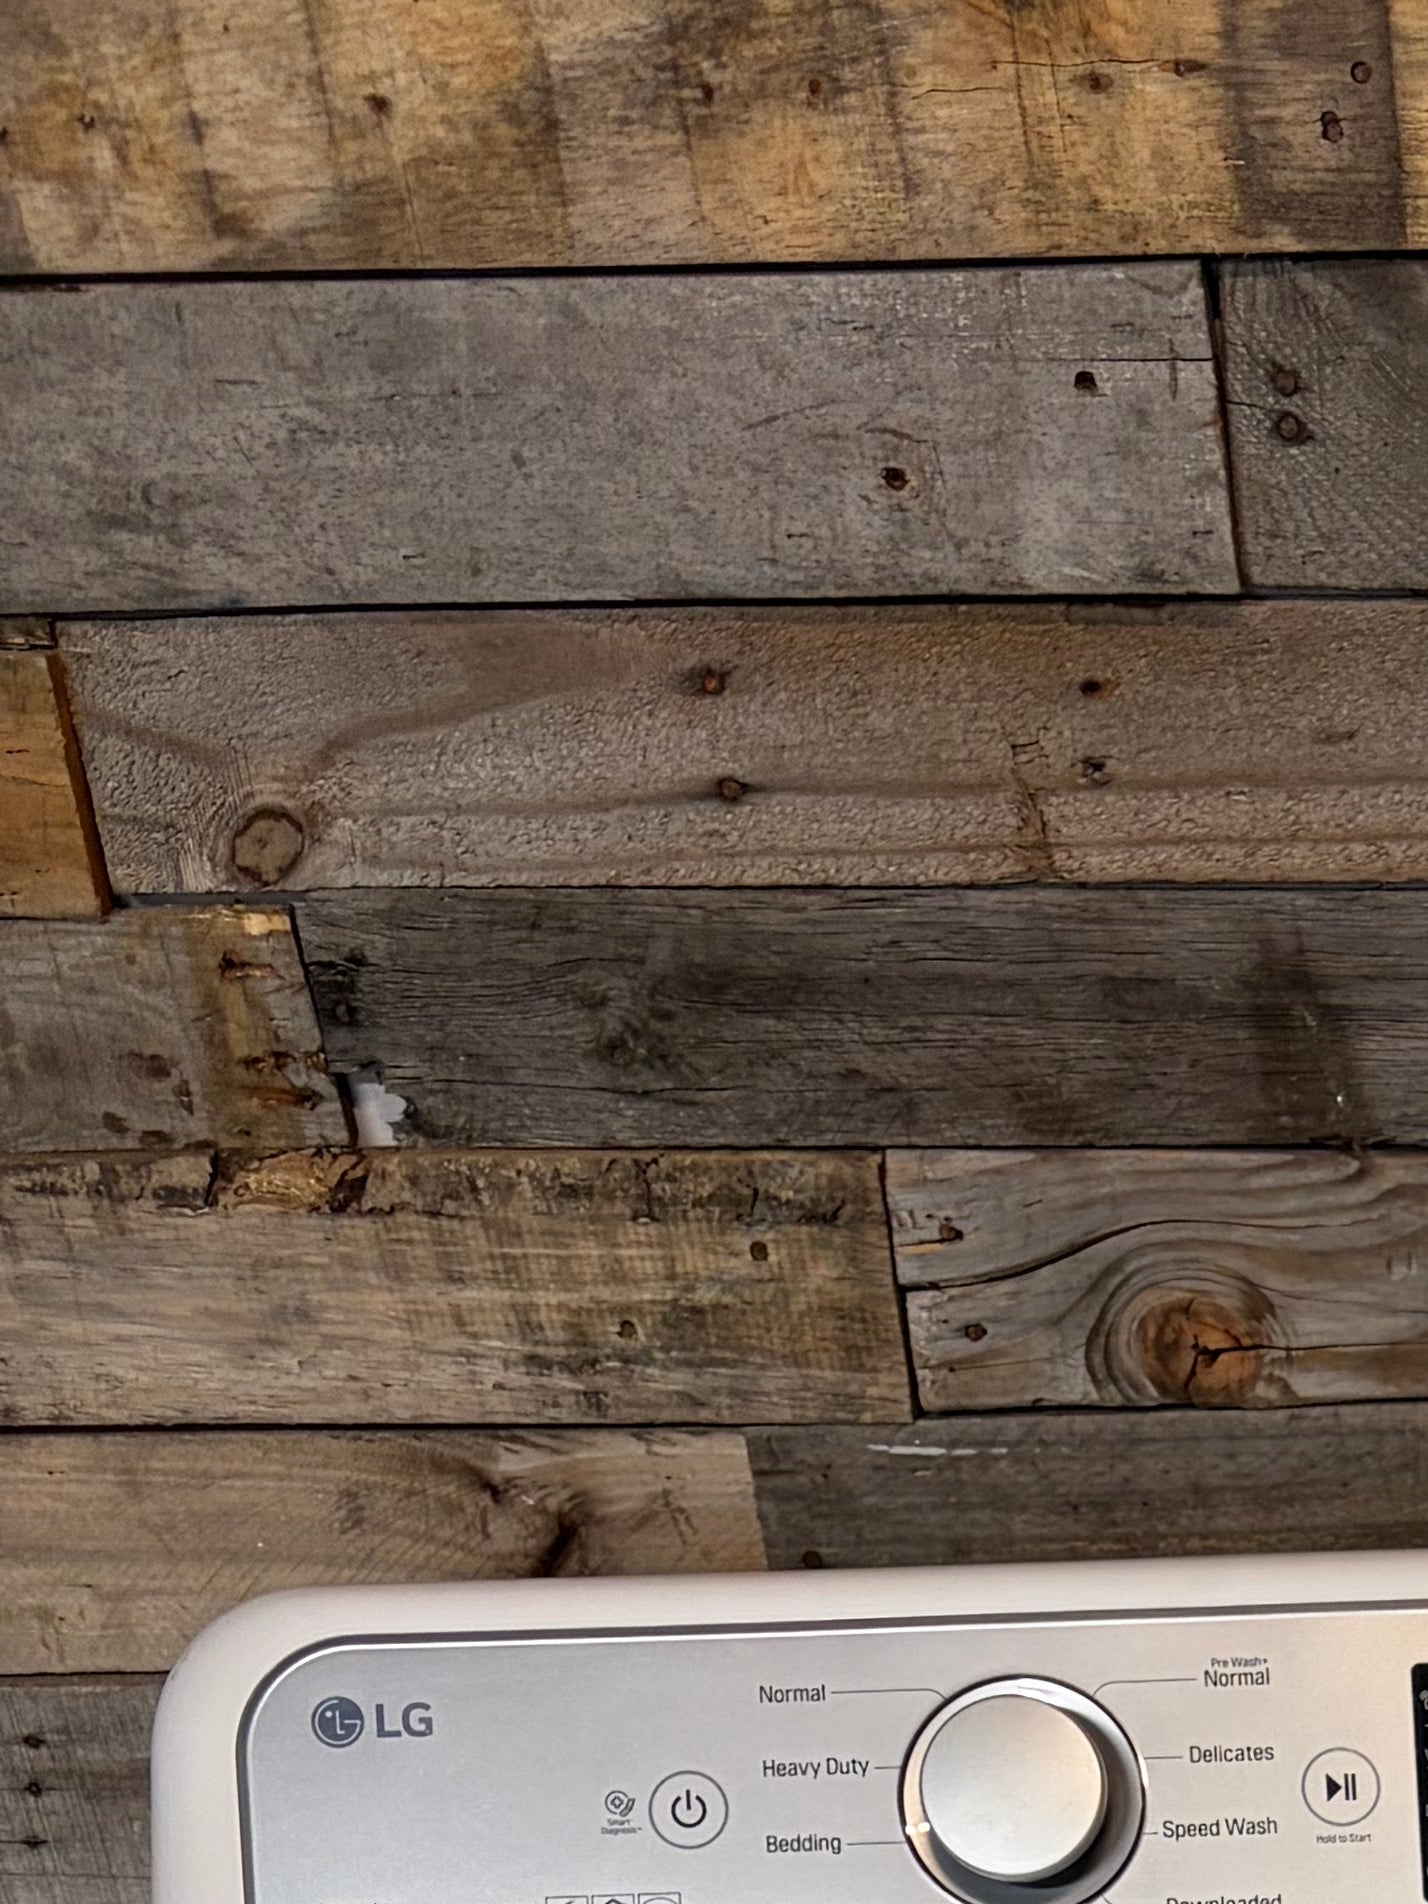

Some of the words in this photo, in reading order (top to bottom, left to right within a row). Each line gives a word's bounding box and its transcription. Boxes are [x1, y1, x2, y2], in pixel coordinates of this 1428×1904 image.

[1211, 1658, 1229, 1668] Pre
[1203, 1667, 1270, 1688] Normal
[759, 1684, 826, 1704] Normal
[374, 1702, 434, 1739] LG
[1189, 1745, 1275, 1764] Delicates
[762, 1759, 821, 1779] Heavy
[826, 1757, 869, 1778] Duty
[1162, 1819, 1220, 1842] Speed
[1225, 1817, 1279, 1836] Wash
[1316, 1834, 1336, 1844] Hold
[1338, 1834, 1347, 1843] to
[1349, 1833, 1371, 1843] Start
[766, 1833, 842, 1855] Bedding
